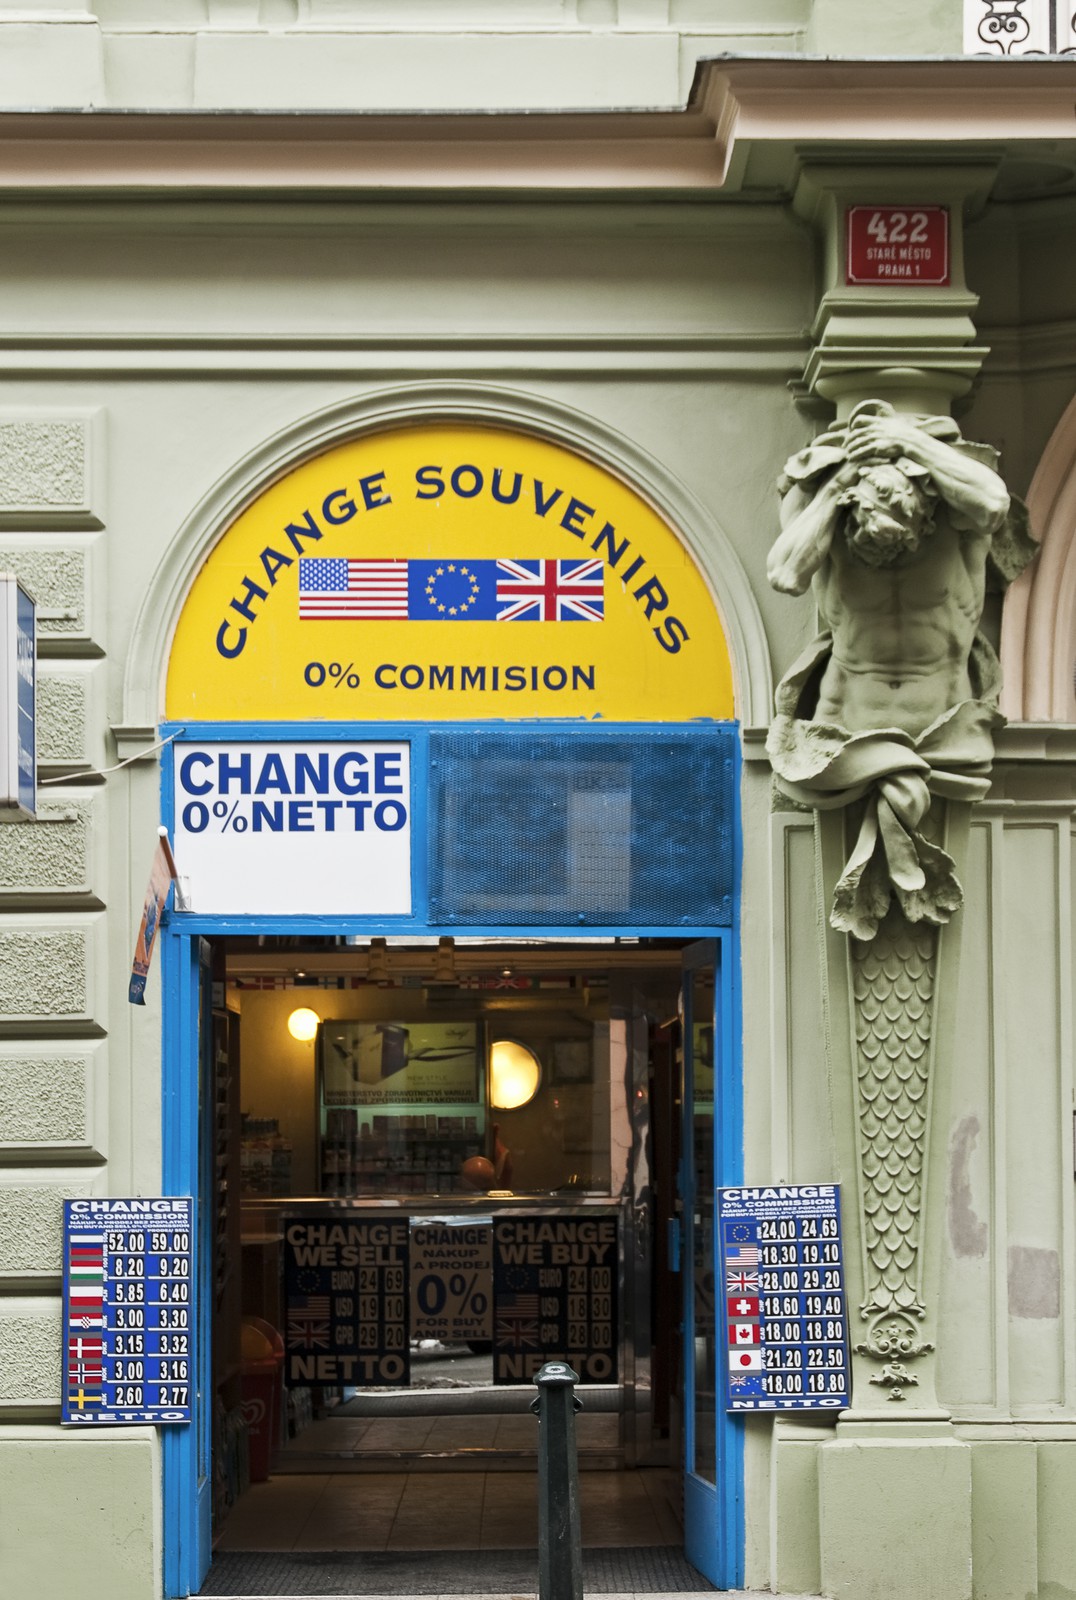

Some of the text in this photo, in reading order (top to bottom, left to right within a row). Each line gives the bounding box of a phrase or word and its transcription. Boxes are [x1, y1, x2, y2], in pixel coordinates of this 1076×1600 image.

[867, 212, 928, 243] 422
[867, 245, 931, 260] STARÉ MĚSTO
[878, 264, 920, 276] PRAHA 1
[215, 464, 692, 659] CHANGE SOUVENIRS
[304, 661, 596, 692] 0% COMMISION
[180, 752, 403, 796] CHANGE
[723, 1186, 835, 1201] CHANGE
[745, 1199, 835, 1207] COMMISSION
[71, 1201, 188, 1212] CHANGE
[287, 1225, 406, 1246] CHANGE
[415, 1229, 487, 1245] CHANGE
[497, 1222, 615, 1243] CHANGE
[762, 1219, 837, 1240] 24,00 24,69
[109, 1233, 189, 1251] 52,00 59,00
[293, 1246, 404, 1266] WE SELL
[423, 1247, 479, 1258] NÁKUP
[499, 1244, 609, 1264] WE BUY
[763, 1244, 839, 1264] 18,30 19,10
[115, 1258, 188, 1277] 8,20 9,20
[429, 1261, 490, 1269] PRODEJ
[331, 1270, 403, 1290] EURO 24 69
[539, 1268, 609, 1289] EURO 24 00
[764, 1270, 840, 1291] 28,00 29,20
[116, 1283, 188, 1303] 5,85 6,40
[417, 1274, 487, 1315] 0%
[335, 1297, 403, 1318] USD 19 10
[541, 1297, 609, 1317] USD 18 30
[765, 1297, 841, 1316] 18,60 19,40
[117, 1309, 188, 1328] 3,00 3,30
[416, 1318, 484, 1326] FOR BUY
[361, 1326, 377, 1346] 29
[386, 1327, 403, 1346] 20
[414, 1330, 490, 1338] AND SELL
[570, 1325, 585, 1344] 28
[593, 1326, 610, 1345] 00
[766, 1321, 842, 1342] 18,00 18,80
[115, 1335, 188, 1354] 3,15 3,32
[291, 1355, 404, 1380] NETTO
[767, 1348, 843, 1368] 21,20 22,50
[115, 1361, 187, 1380] 3,00 3,16
[768, 1374, 844, 1393] 18,00 18,80
[116, 1387, 188, 1406] 2,60 2,77
[733, 1399, 842, 1408] NETTO
[70, 1412, 185, 1421] NETTO
